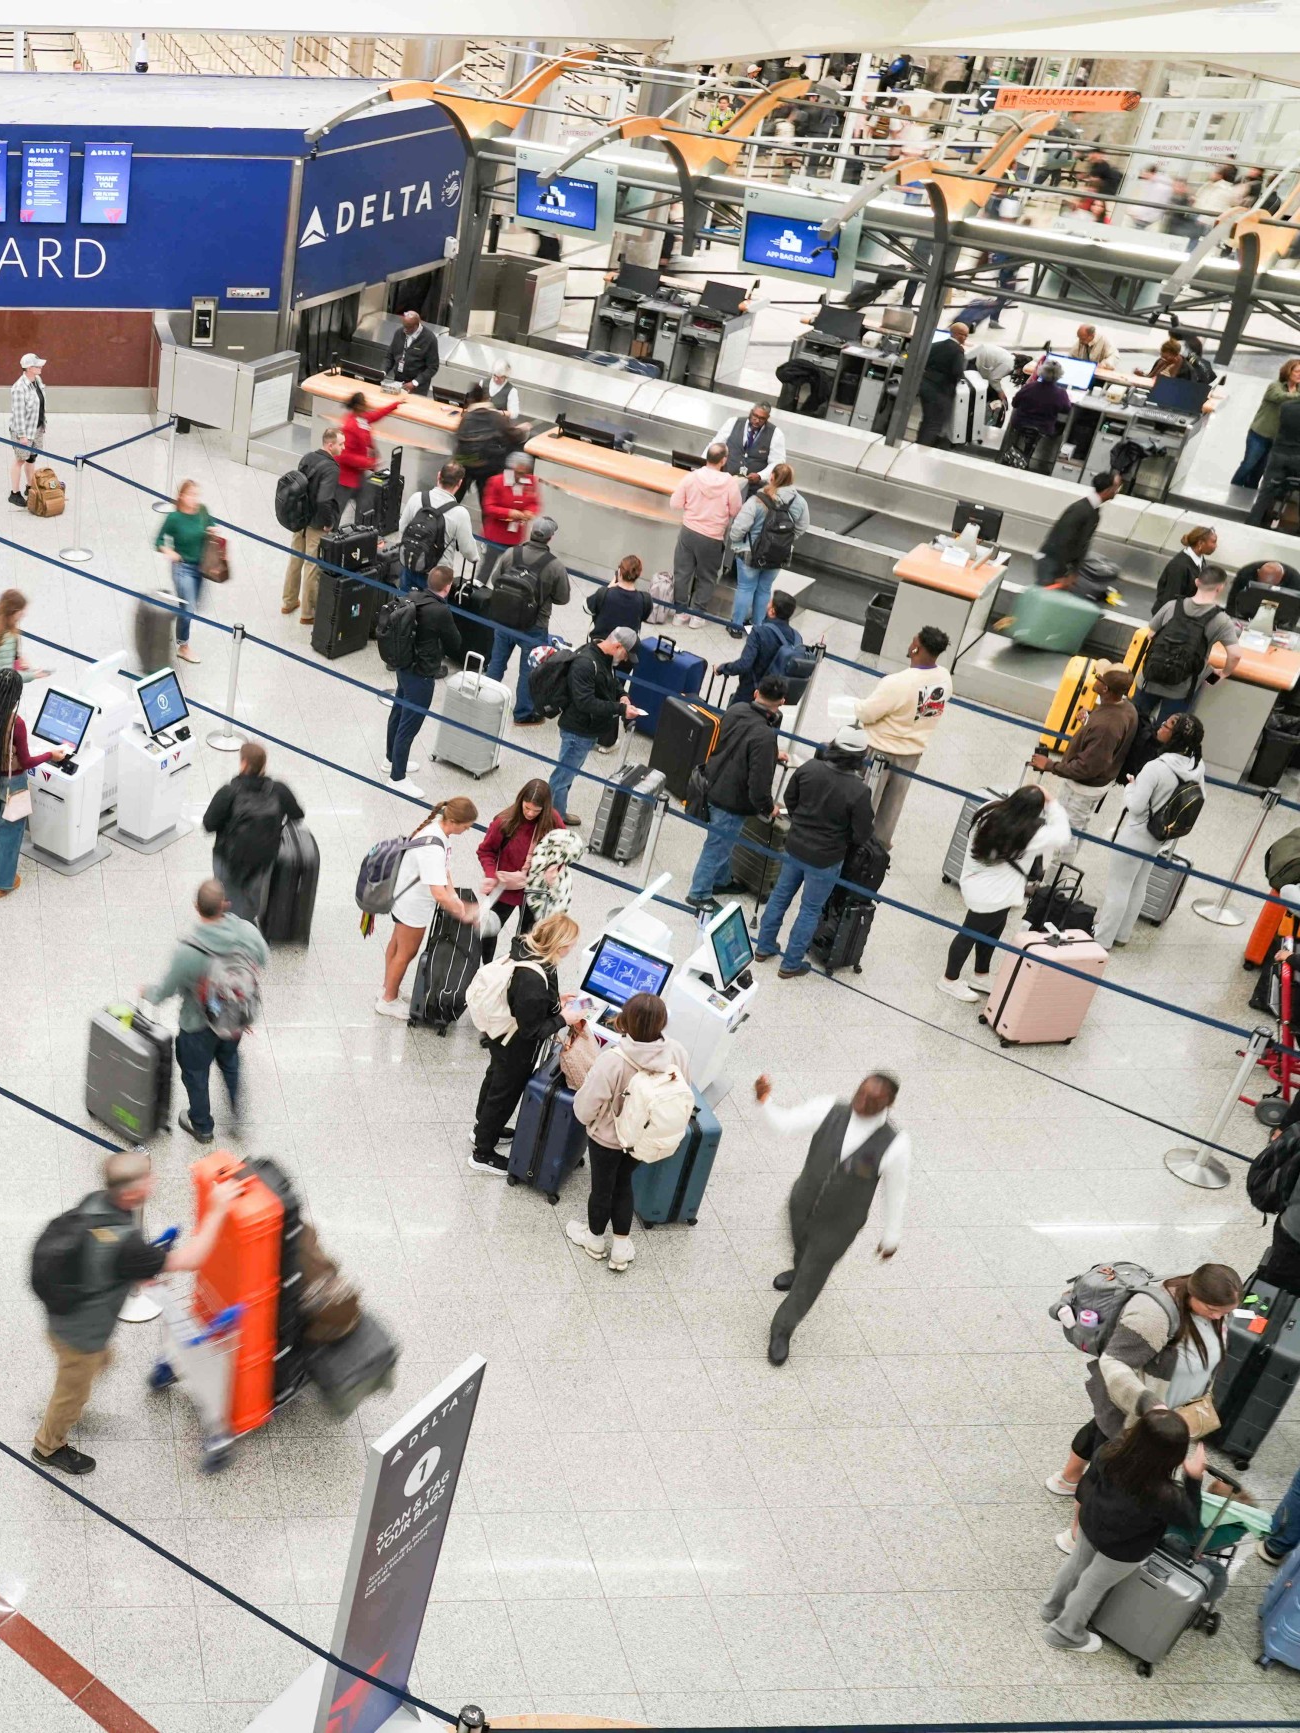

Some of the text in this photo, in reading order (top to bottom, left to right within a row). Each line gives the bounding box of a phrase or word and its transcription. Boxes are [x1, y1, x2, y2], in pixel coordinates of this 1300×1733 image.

[1019, 96, 1075, 106] Restrooms
[604, 168, 614, 176] 46
[336, 181, 432, 235] DELTA
[748, 192, 759, 200] 47
[560, 210, 576, 218] DROP
[766, 250, 814, 264] APP BAG DROP
[408, 1397, 458, 1450] DELTA
[419, 1458, 428, 1482] 1
[376, 1470, 450, 1547] SCAN & TAG
[376, 1485, 446, 1556] YOUR BAGS
[366, 1530, 428, 1592] pass at kiosk to print
[368, 1514, 438, 1584] Scan your app boarding
[364, 1584, 377, 1599] bag
